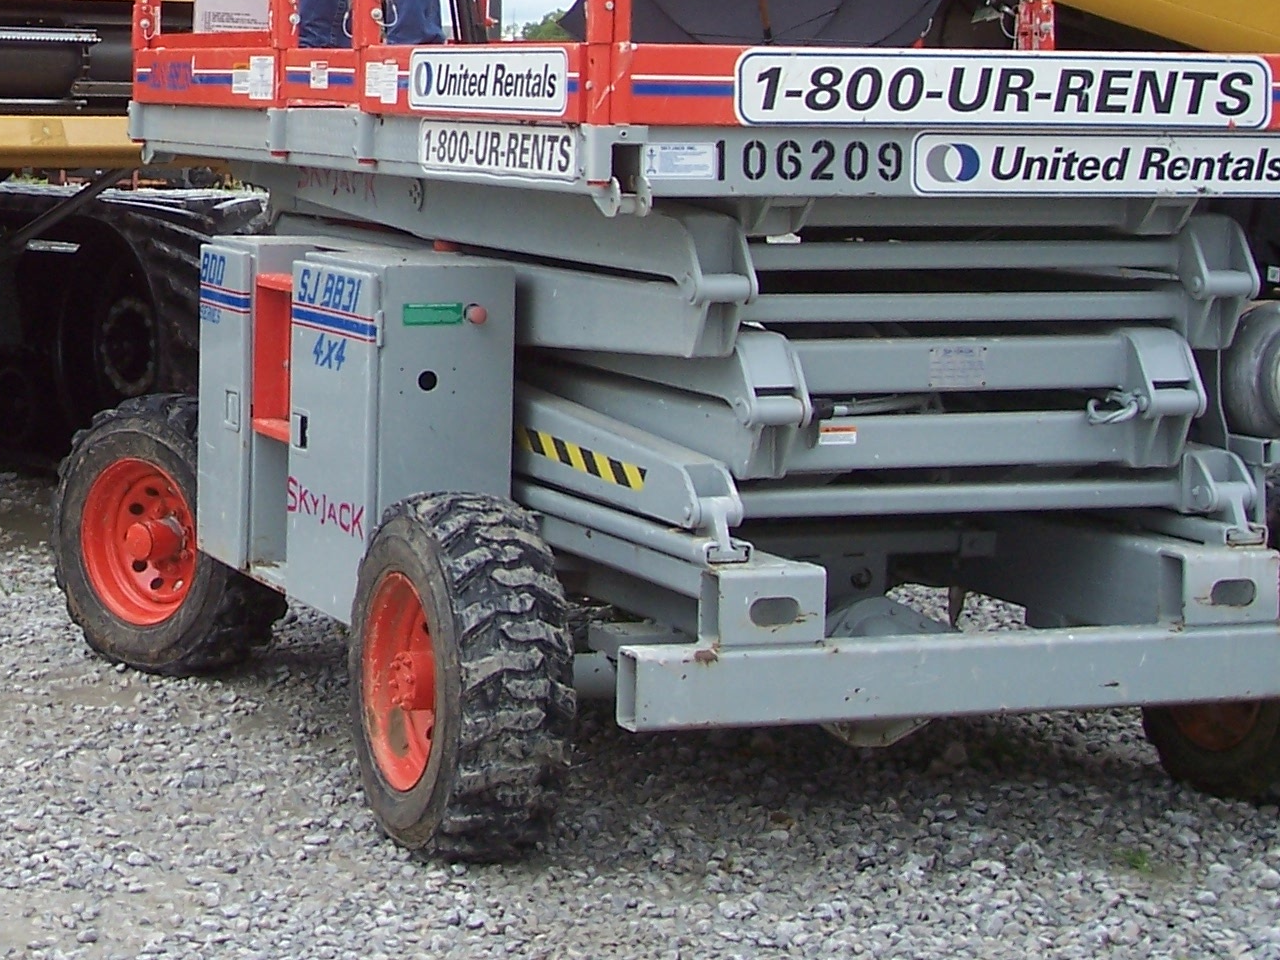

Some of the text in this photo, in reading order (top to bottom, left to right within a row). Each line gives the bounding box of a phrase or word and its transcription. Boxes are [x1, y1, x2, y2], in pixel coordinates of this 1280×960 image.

[436, 63, 490, 98] United
[492, 64, 557, 98] Rentals
[756, 66, 1254, 116] 1-800-UR-RENTS
[425, 129, 571, 172] 1-800-UR-RENTS
[716, 140, 903, 181] 106209
[991, 146, 1280, 182] United Rentals
[201, 253, 226, 286] 800
[298, 269, 321, 302] SJ
[287, 476, 364, 542] SKYJACK
